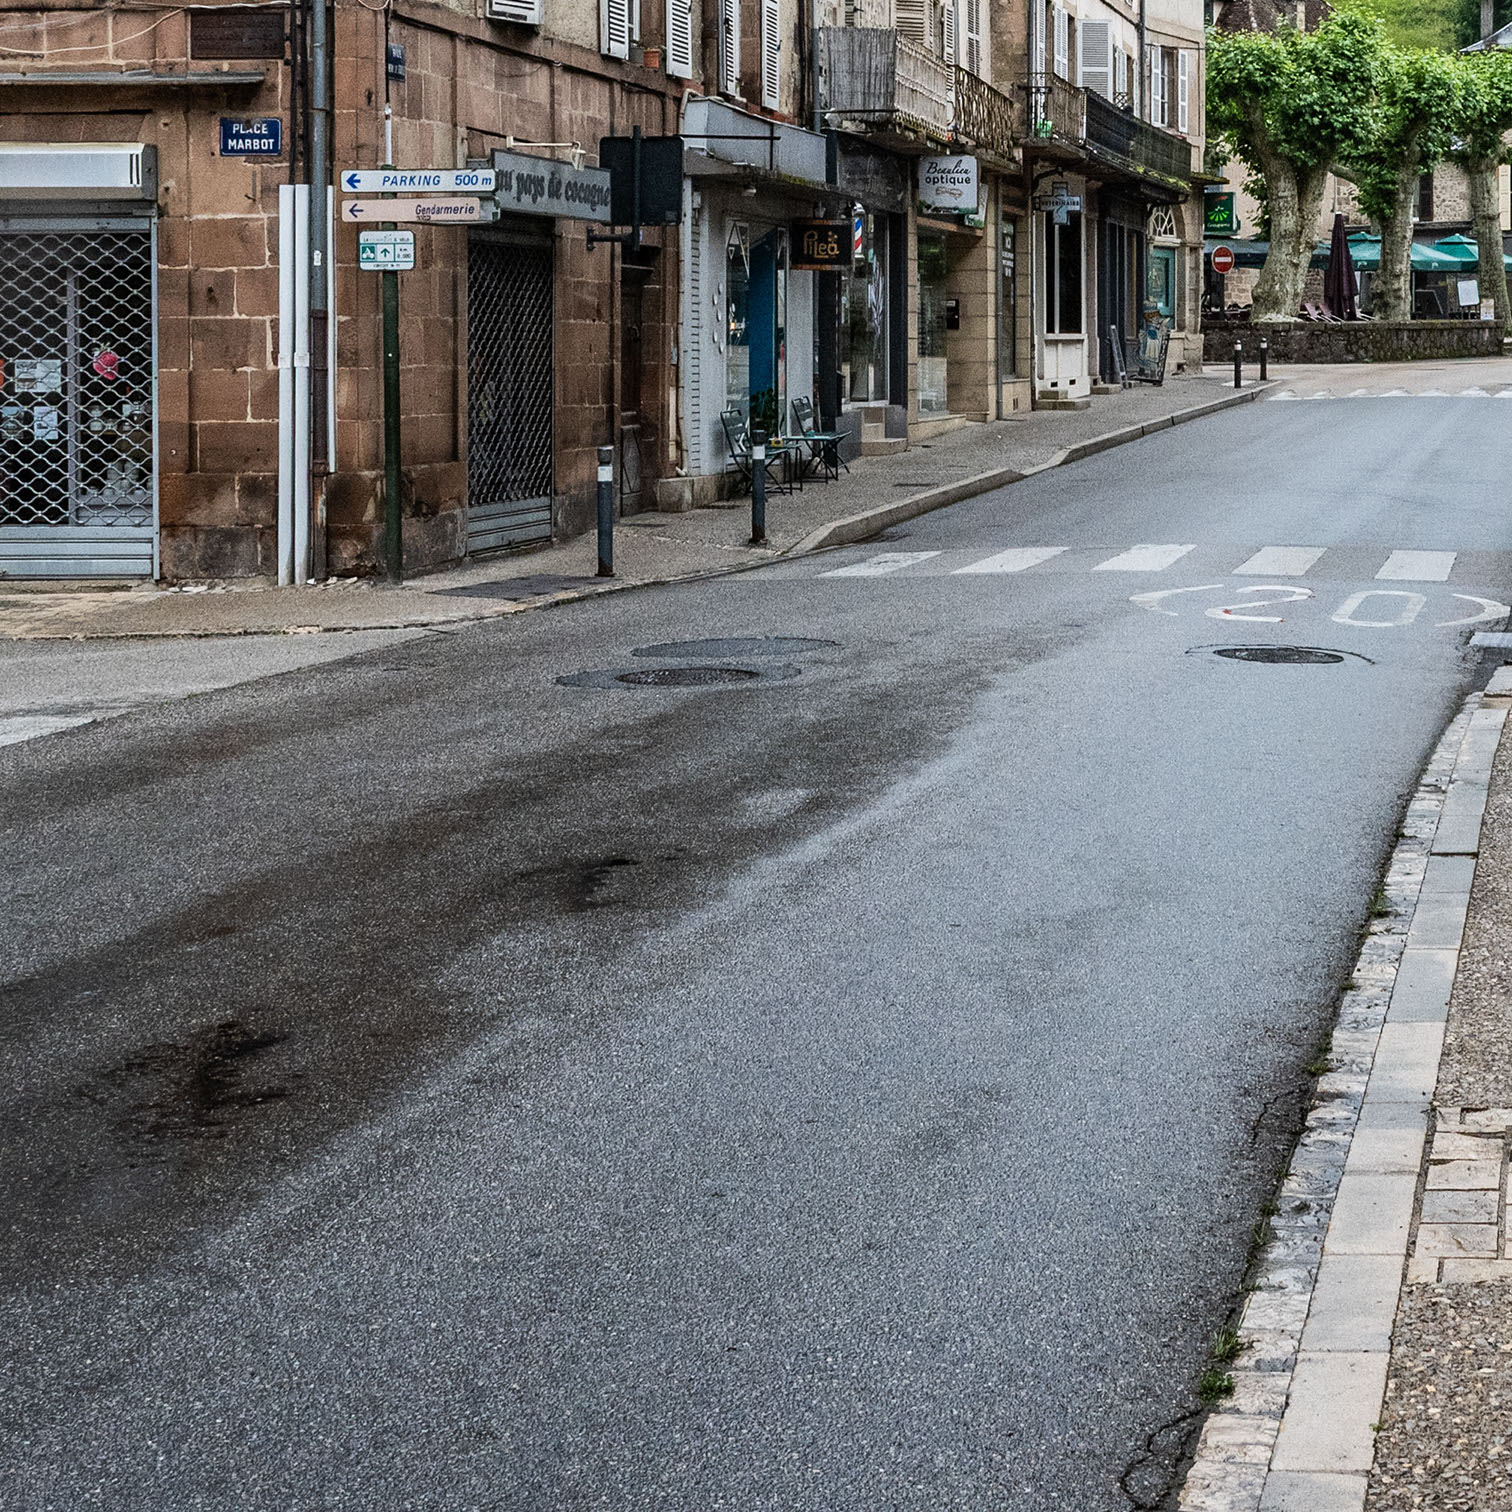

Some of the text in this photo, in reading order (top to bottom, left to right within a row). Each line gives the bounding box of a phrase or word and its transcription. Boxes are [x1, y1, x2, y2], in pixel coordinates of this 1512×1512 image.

[228, 138, 275, 150] MARBOT
[926, 159, 972, 175] Beaulieu
[382, 174, 492, 187] PARKING 500 m
[925, 175, 971, 186] optique
[548, 171, 562, 200] de
[565, 180, 610, 212] cocagne
[415, 203, 475, 215] Gendarmerie
